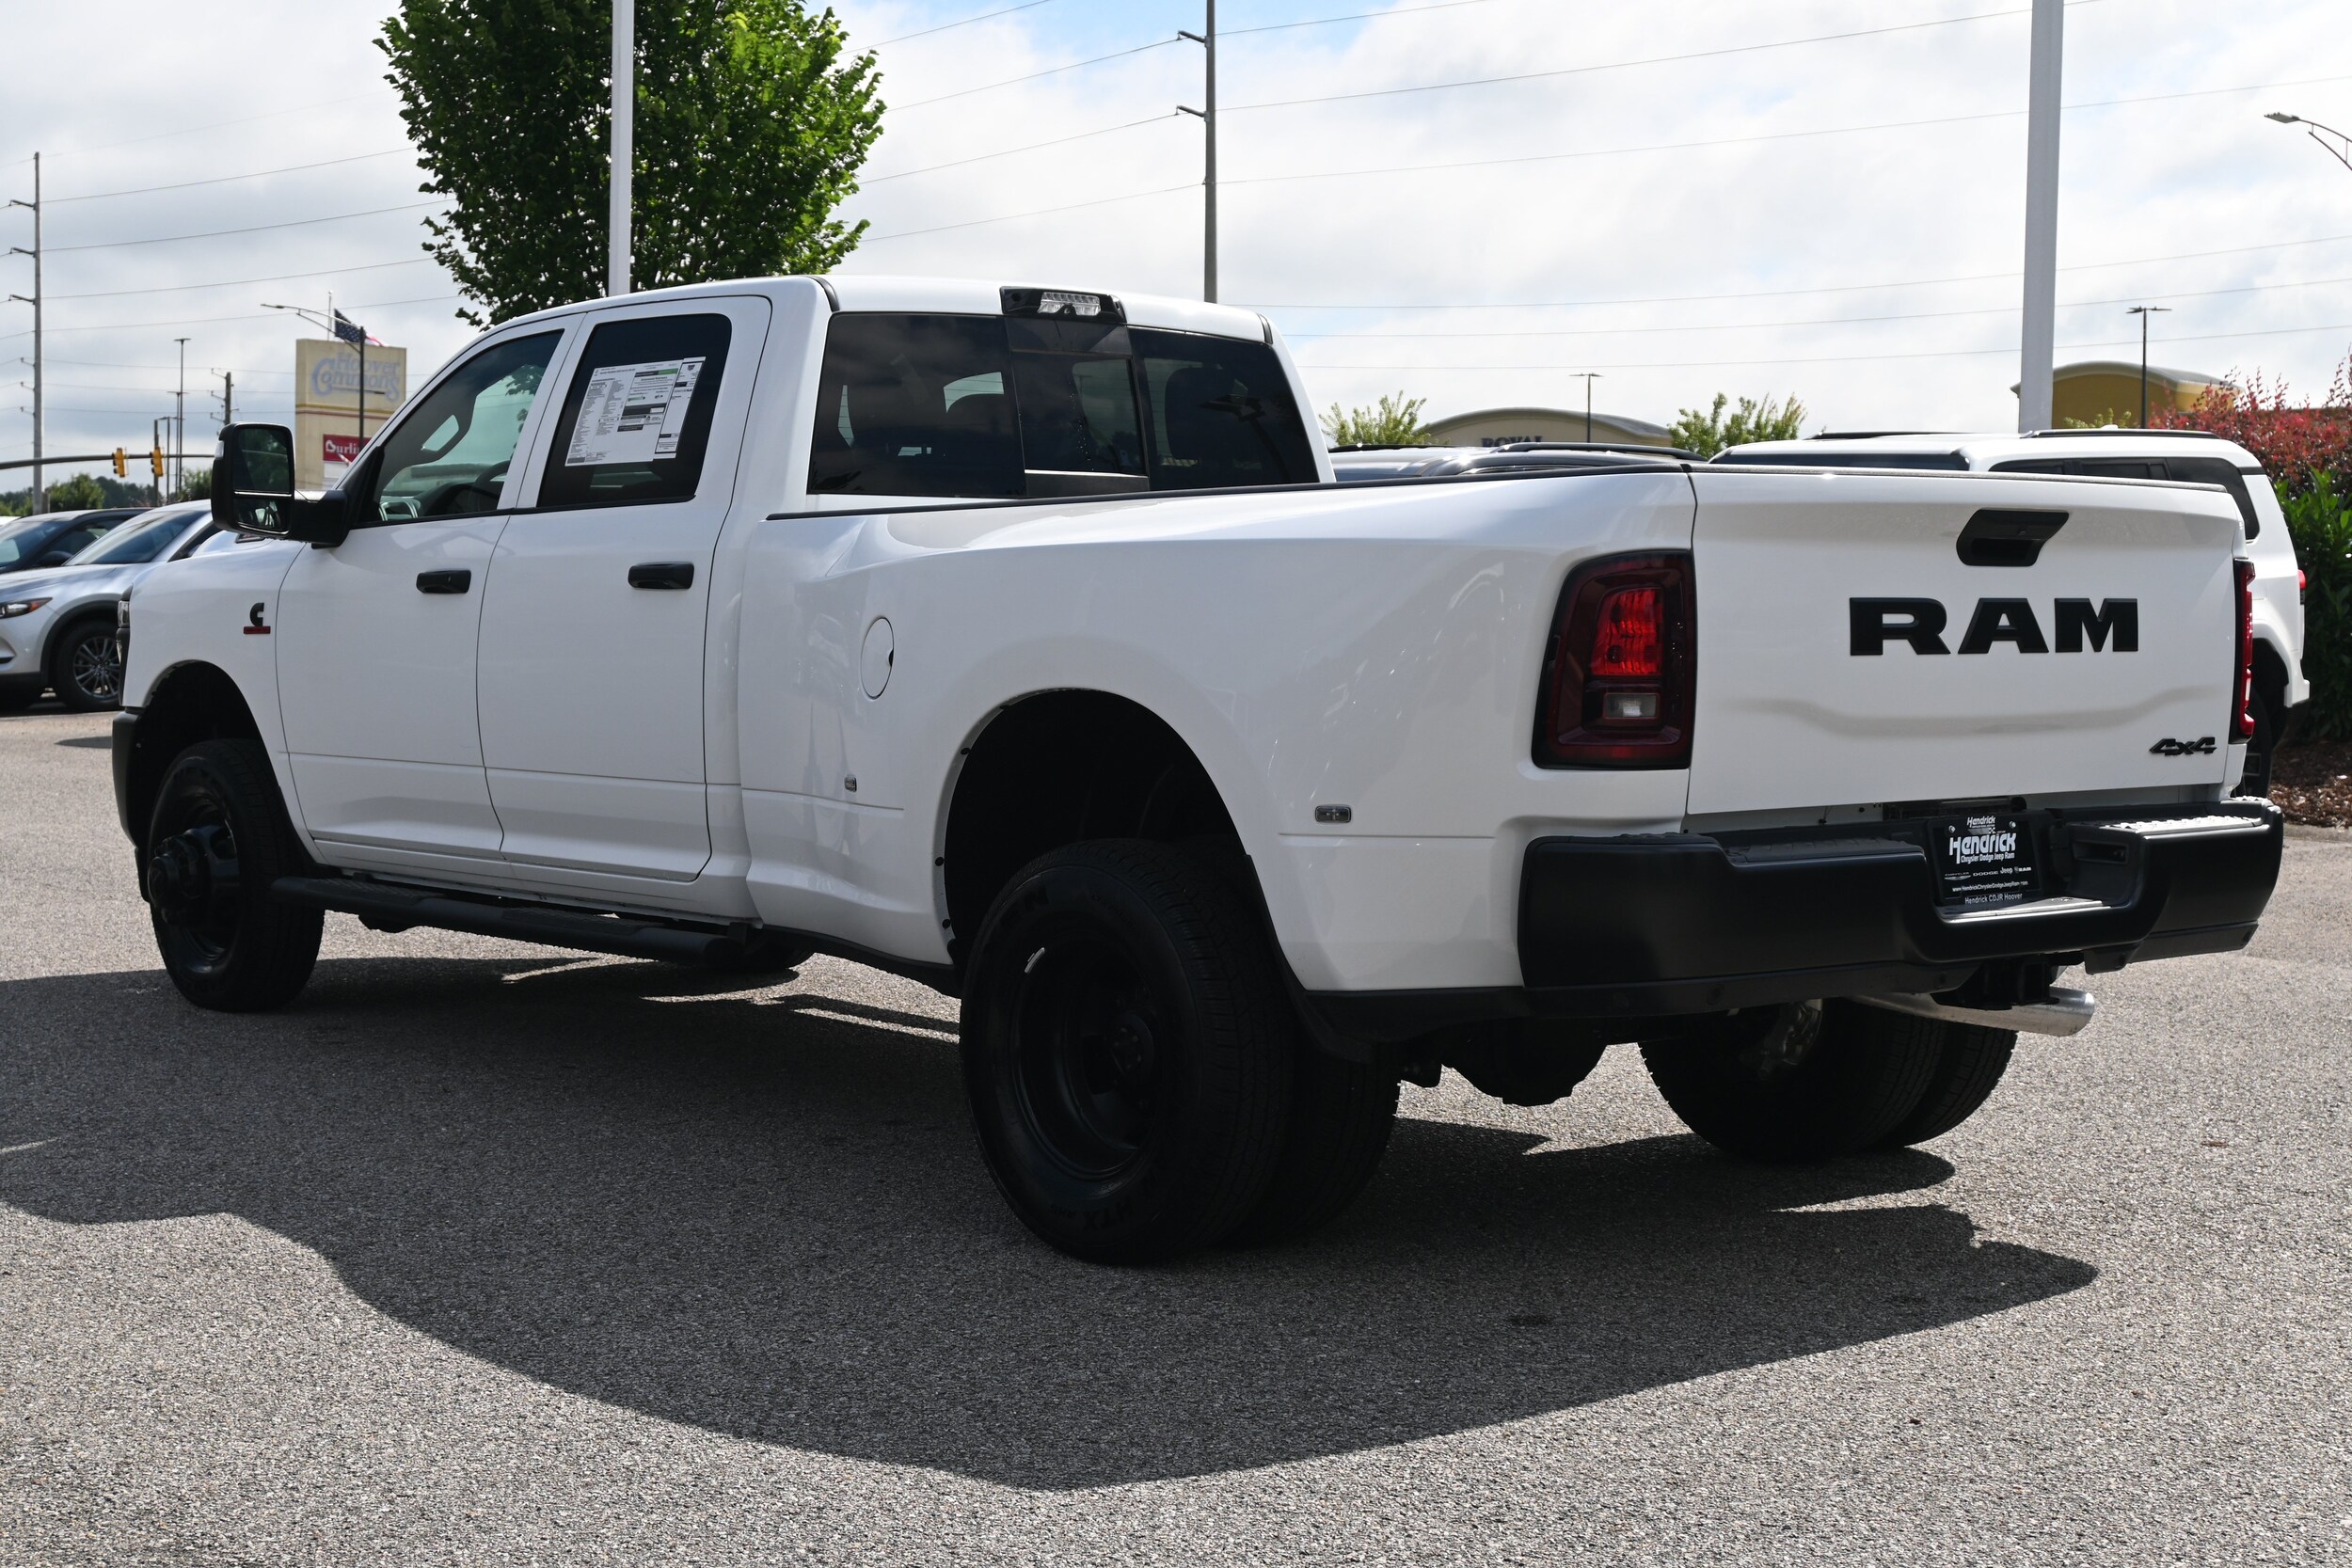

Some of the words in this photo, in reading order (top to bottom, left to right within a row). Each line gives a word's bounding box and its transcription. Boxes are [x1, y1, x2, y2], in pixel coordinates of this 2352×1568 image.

[334, 353, 400, 373] Hoover
[311, 358, 400, 402] Commons
[1850, 597, 2138, 656] RAM
[2149, 736, 2217, 756] 4x4
[1967, 816, 1995, 828] Hendrick
[1949, 832, 2016, 863] Hendrick
[1961, 854, 1979, 864] Chrysler
[1979, 853, 1994, 863] Dodge
[1994, 852, 2005, 861] Jeep
[2000, 866, 2013, 875] Jeep
[1964, 896, 1988, 905] Hendrick
[2004, 893, 2024, 901] Hoover
